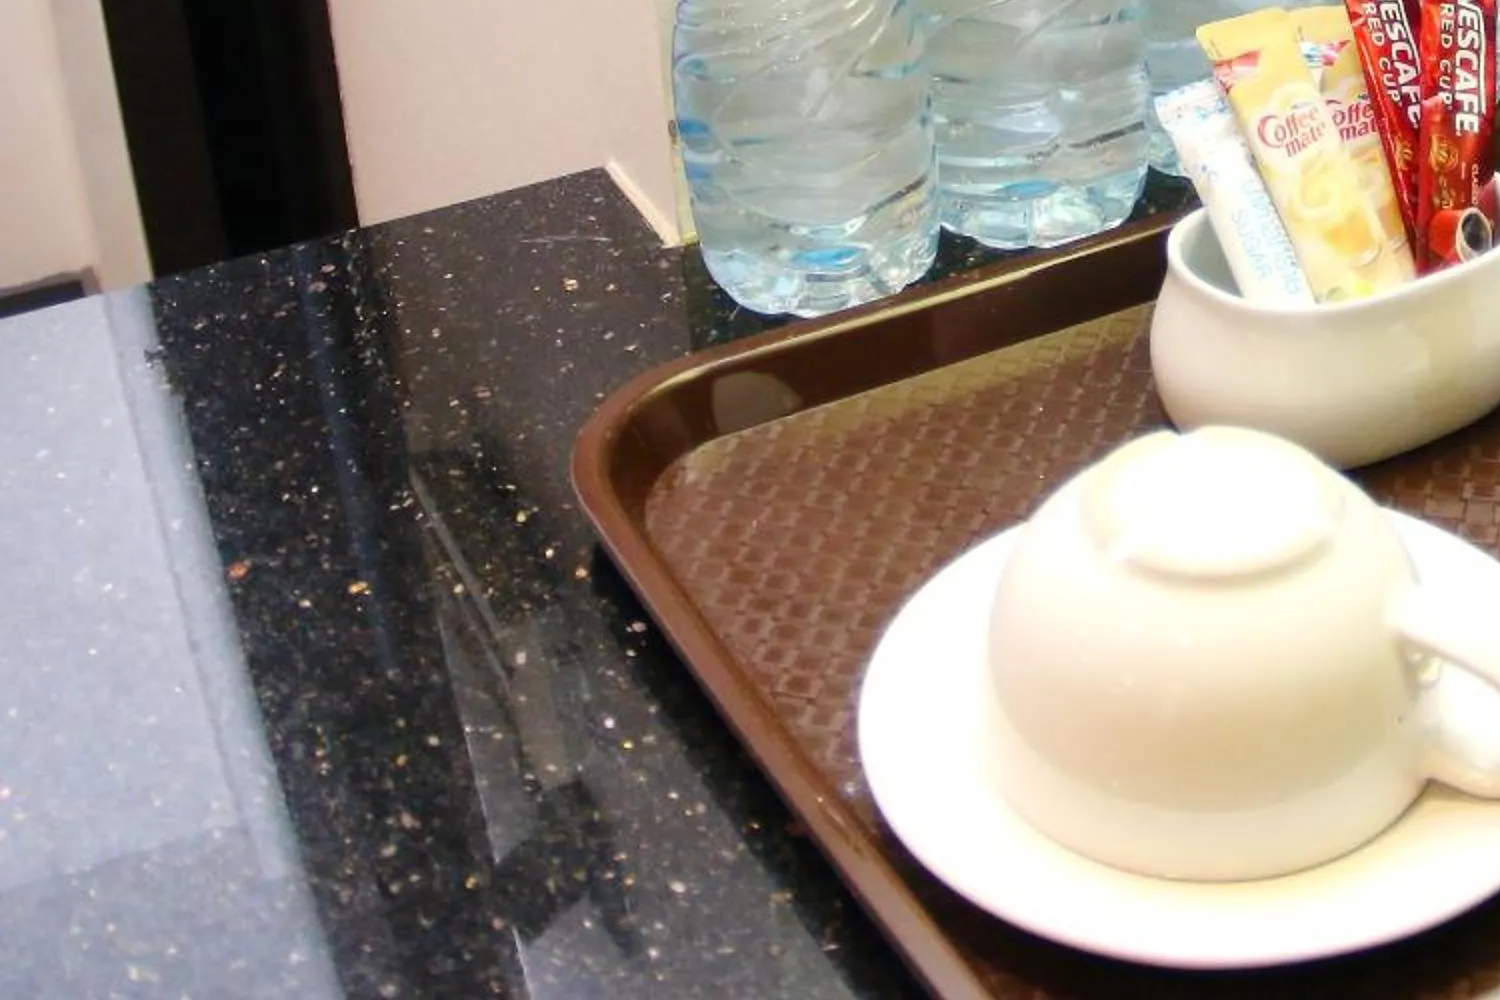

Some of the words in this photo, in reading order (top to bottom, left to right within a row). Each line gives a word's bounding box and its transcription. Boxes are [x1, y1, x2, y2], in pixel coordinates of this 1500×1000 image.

[1440, 3, 1454, 49] RED
[1361, 1, 1385, 46] RED
[1379, 57, 1401, 104] CUP
[1439, 59, 1453, 105] CUP
[1257, 105, 1319, 149] Coffee
[1325, 99, 1374, 127] offe
[1340, 118, 1378, 142] mat
[1285, 121, 1327, 157] mate
